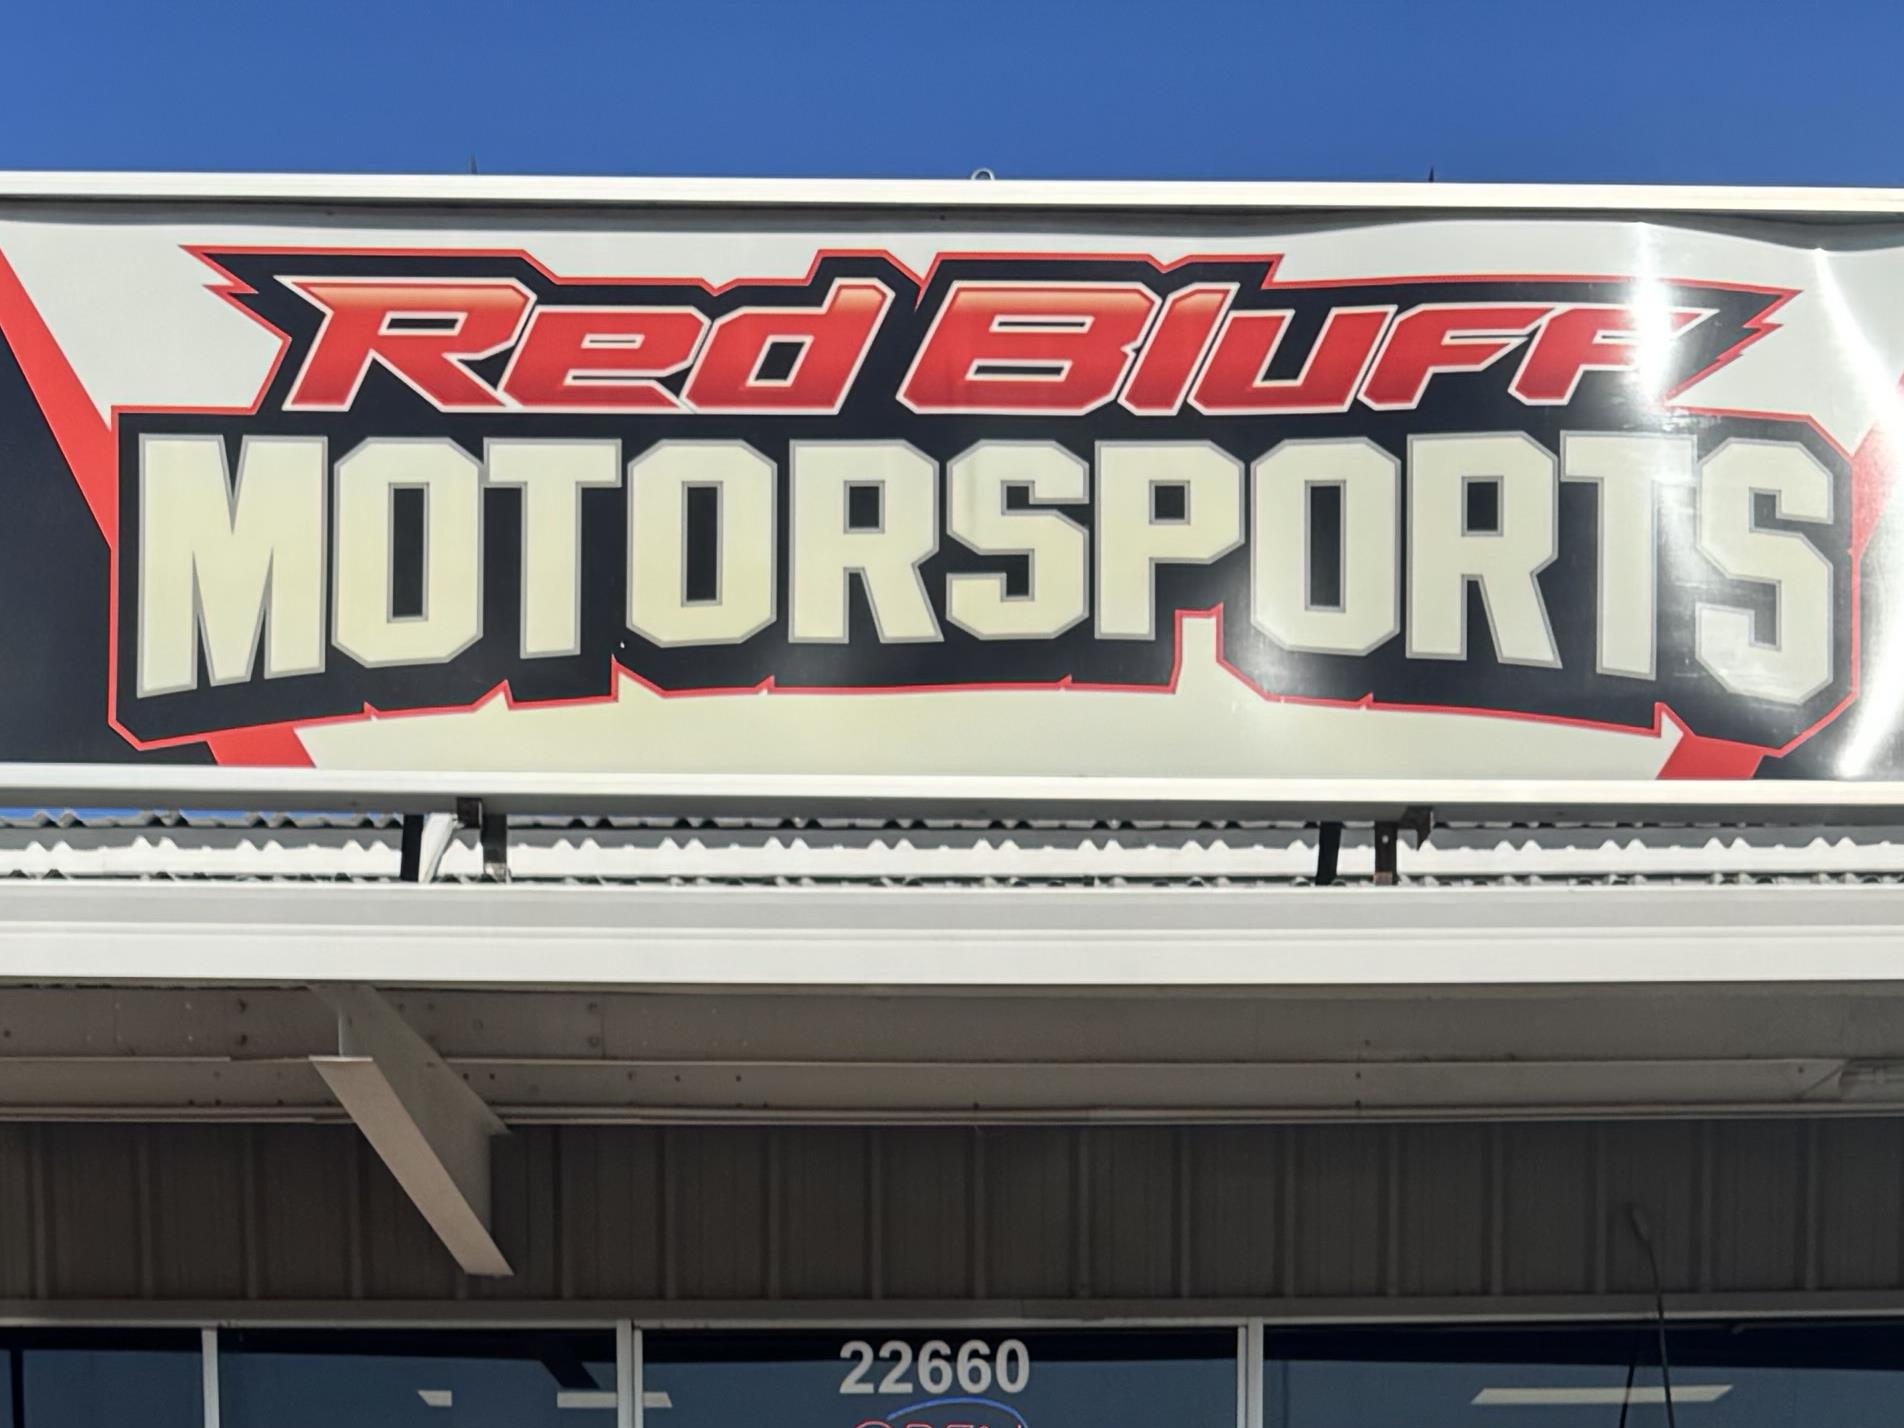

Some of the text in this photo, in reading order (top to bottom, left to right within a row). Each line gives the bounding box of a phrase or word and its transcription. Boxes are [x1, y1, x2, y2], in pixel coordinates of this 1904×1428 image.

[290, 278, 1720, 413] Red Bluff
[136, 430, 1834, 705] MOTORSPORTS
[839, 1339, 1030, 1394] 22660
